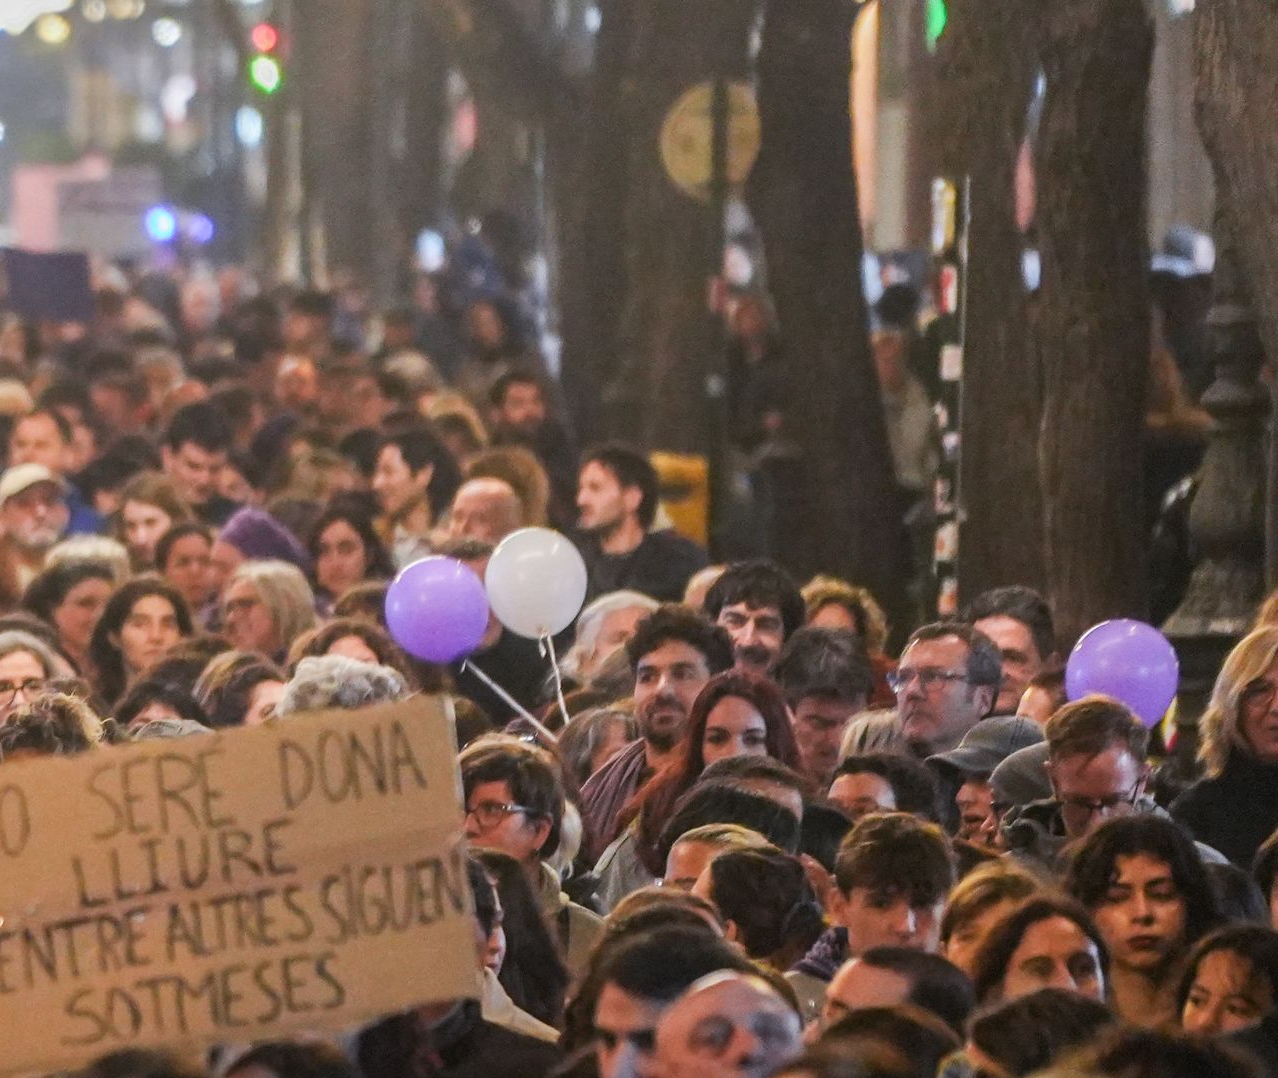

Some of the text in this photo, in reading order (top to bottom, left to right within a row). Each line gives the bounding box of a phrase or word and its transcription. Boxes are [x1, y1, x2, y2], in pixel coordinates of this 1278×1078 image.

[278, 718, 427, 812] DONA
[70, 817, 297, 909] LLIURE
[164, 883, 315, 963] ALTRES
[317, 848, 465, 946] SIGUEN
[58, 950, 348, 1046] SOTMESES
